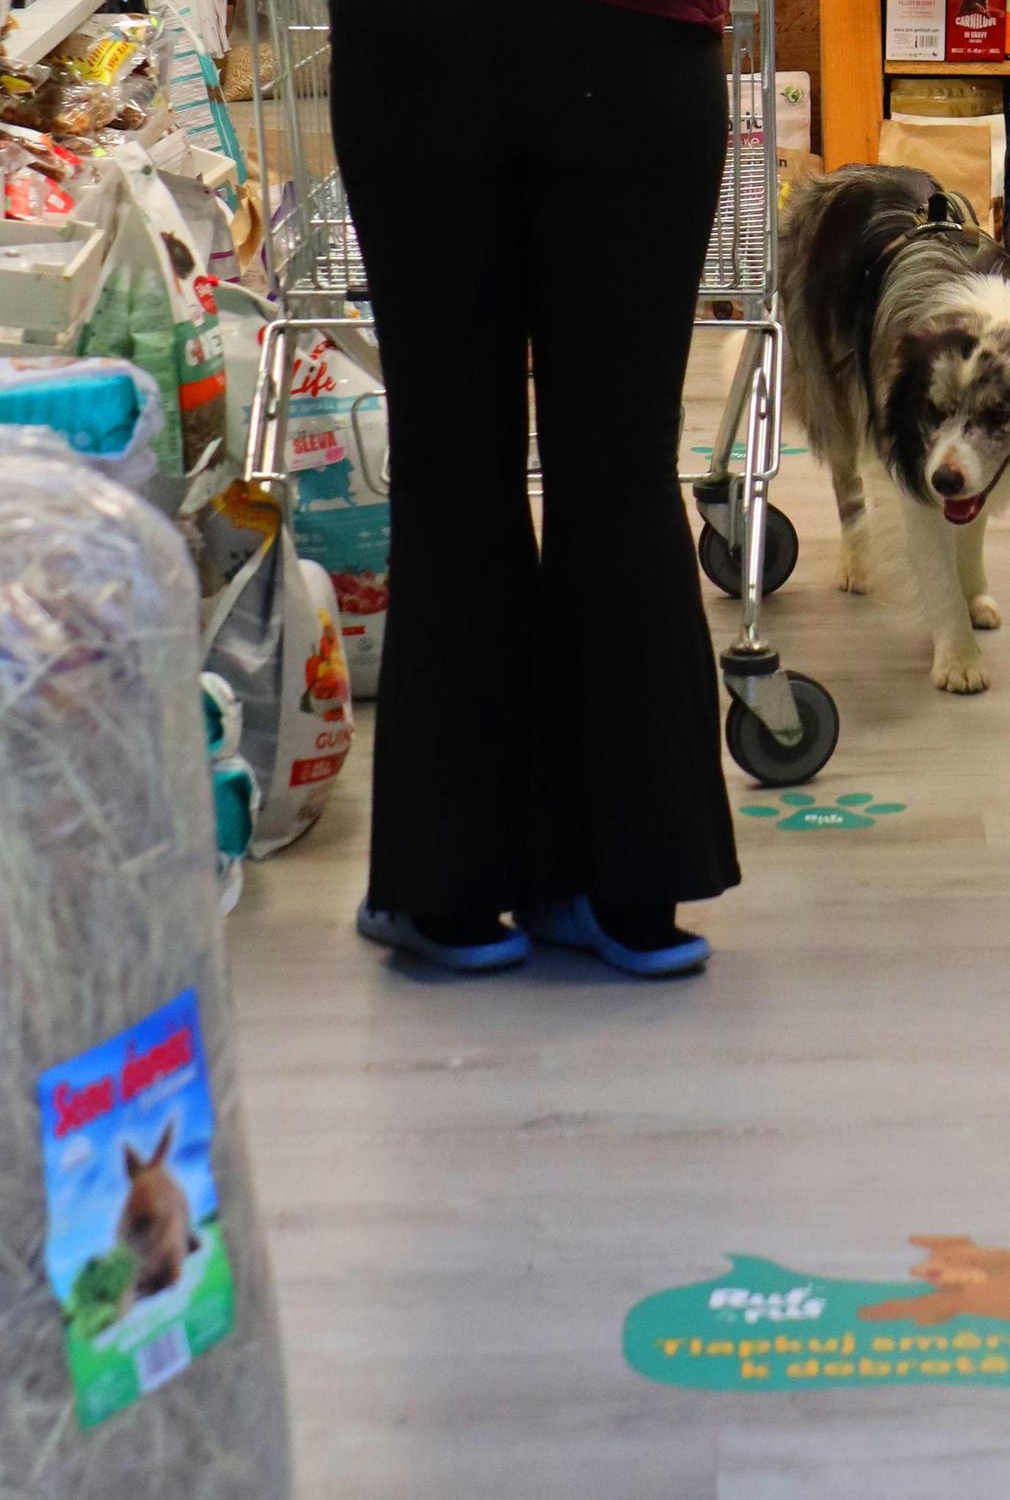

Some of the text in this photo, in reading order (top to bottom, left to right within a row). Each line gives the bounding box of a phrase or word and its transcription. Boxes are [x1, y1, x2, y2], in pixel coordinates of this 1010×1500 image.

[955, 13, 997, 29] CARNILOVE
[971, 31, 987, 39] GRAVY
[293, 431, 337, 454] SLEVA
[656, 1332, 856, 1358] Tlapkuj
[741, 1355, 1010, 1379] k dobrotě
